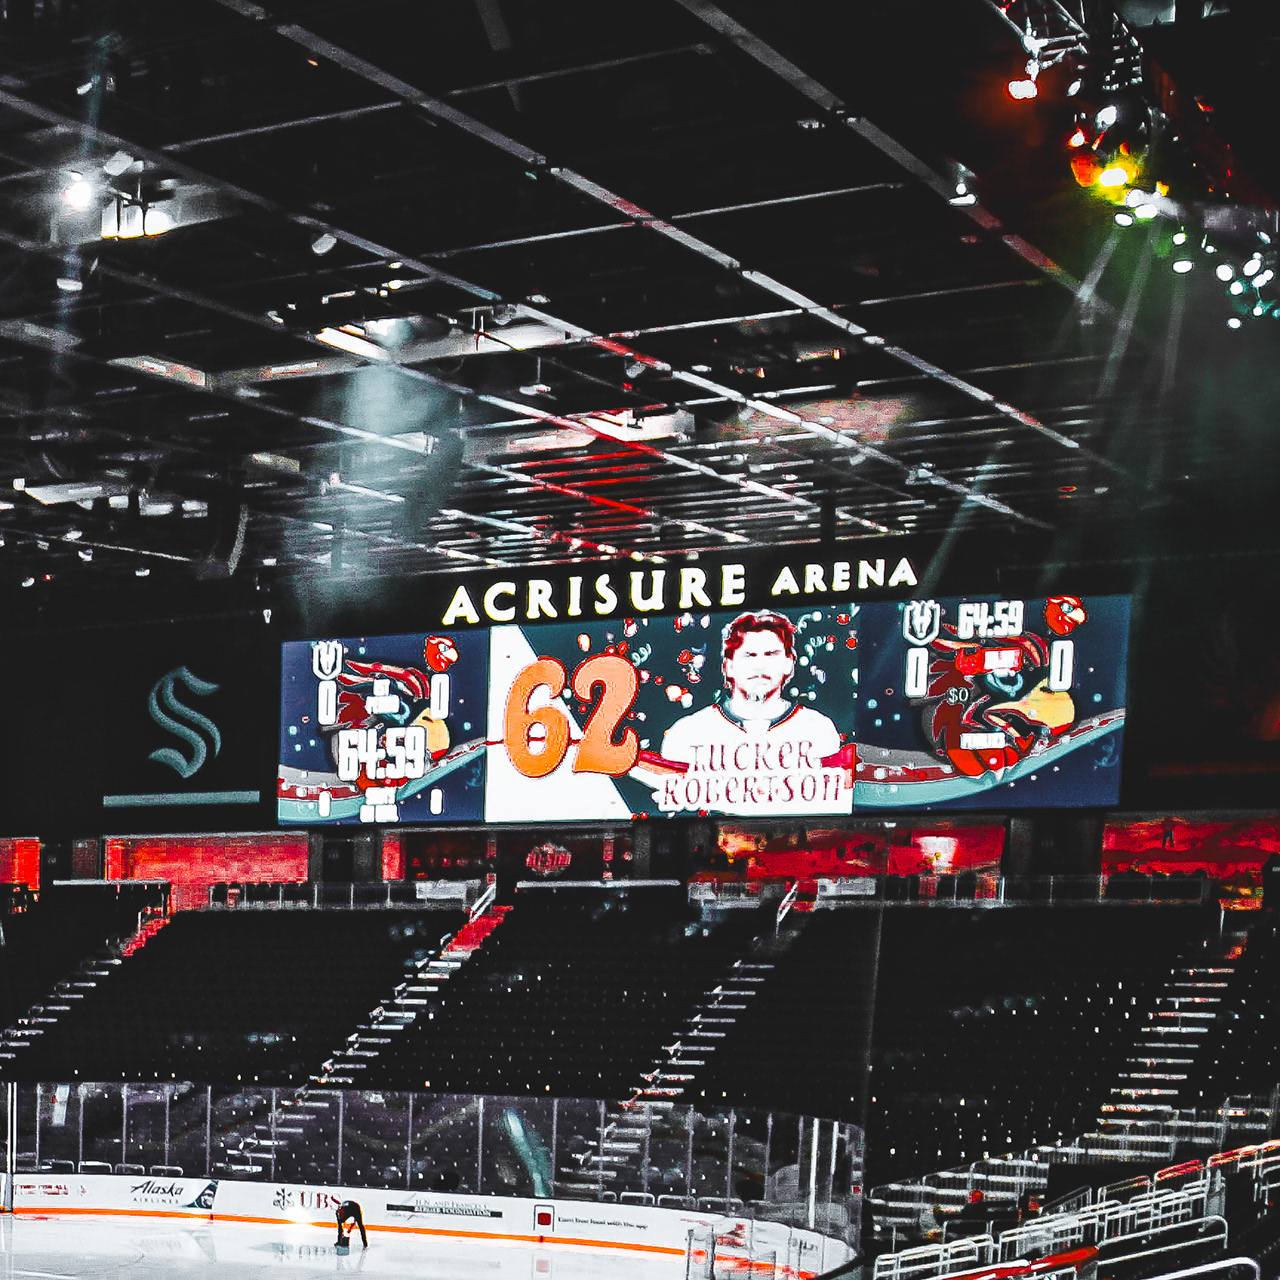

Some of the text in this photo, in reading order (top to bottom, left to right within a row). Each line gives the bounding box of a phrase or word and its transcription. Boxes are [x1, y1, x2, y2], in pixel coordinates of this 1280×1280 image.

[441, 557, 918, 625] ACRISURE ARENA
[504, 653, 640, 778] 62
[131, 1180, 184, 1197] Alaska
[299, 1190, 341, 1209] UBS
